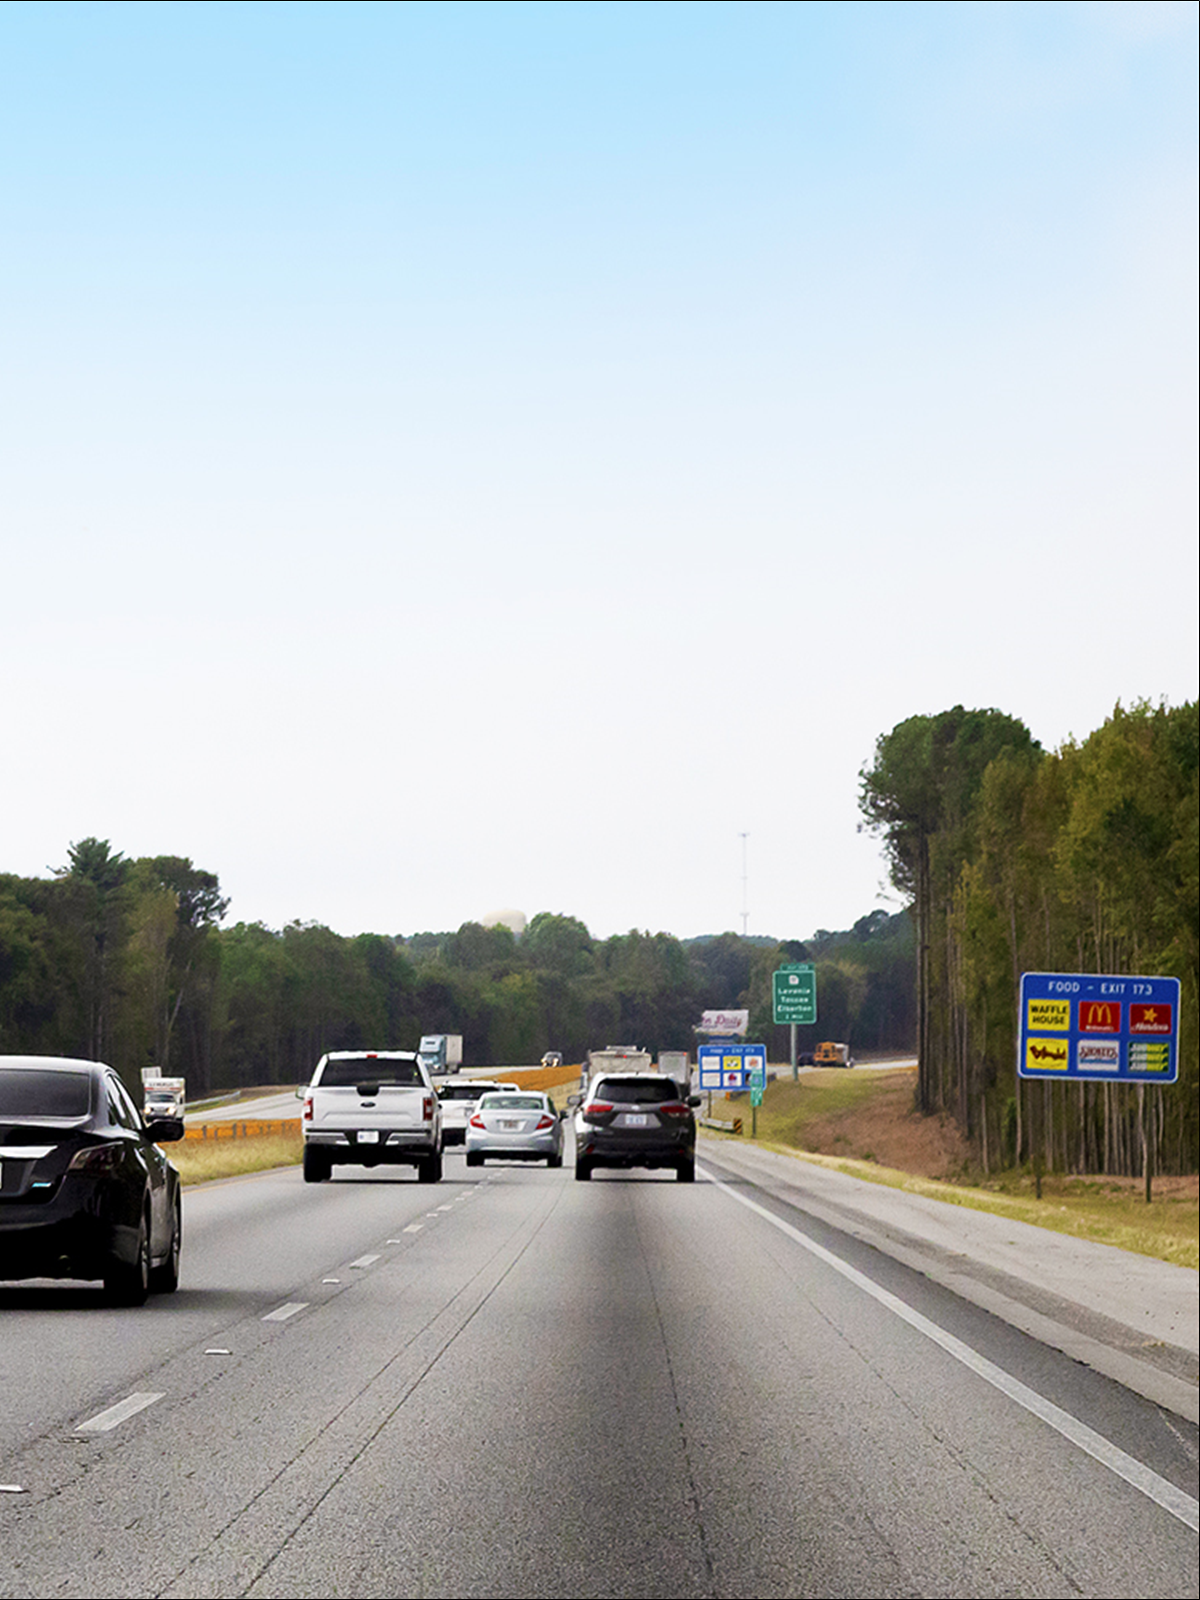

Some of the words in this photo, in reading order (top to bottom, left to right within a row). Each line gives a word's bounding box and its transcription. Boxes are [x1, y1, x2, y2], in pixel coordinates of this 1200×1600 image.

[1048, 981, 1080, 993] FOOD
[1101, 982, 1126, 994] EXIT
[1133, 984, 1153, 995] 173
[1030, 1005, 1067, 1014] WAFFLE
[1032, 1015, 1065, 1025] HOUSE
